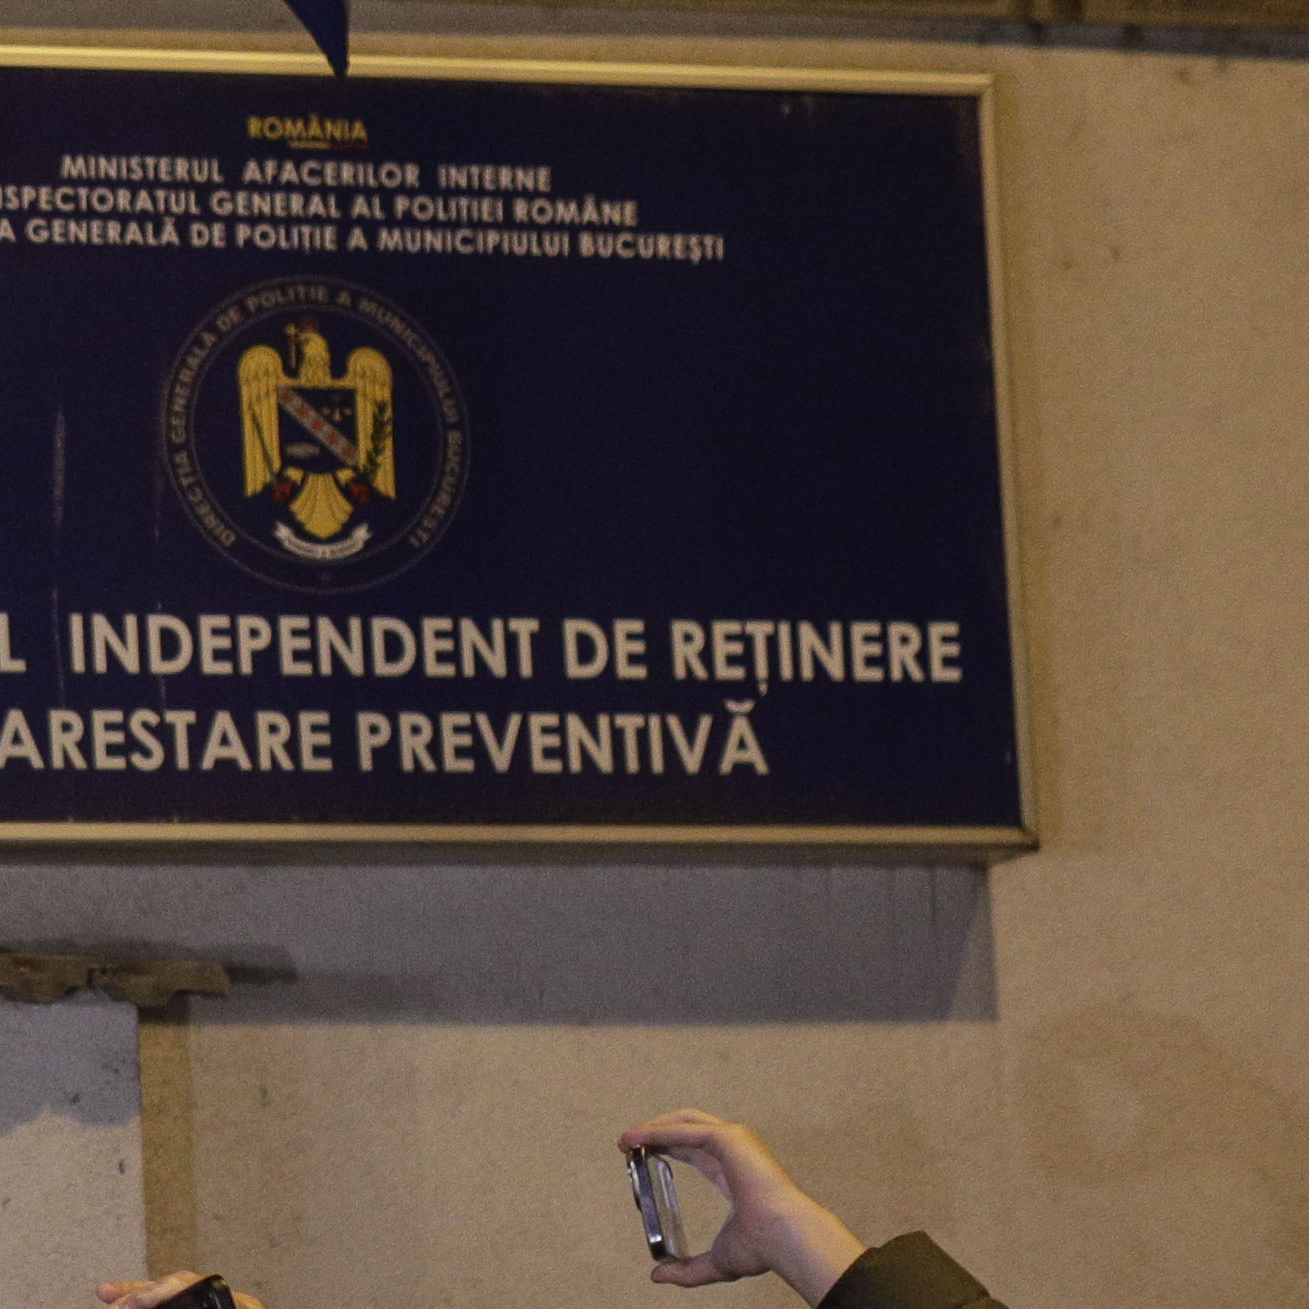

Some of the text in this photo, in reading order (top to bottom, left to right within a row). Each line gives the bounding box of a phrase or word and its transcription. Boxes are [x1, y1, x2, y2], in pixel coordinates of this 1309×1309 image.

[247, 114, 368, 143] ROMÂNIA
[61, 155, 552, 193] MINISTERUL AFACERILOR INTERNE
[209, 190, 341, 219] GENERAL
[350, 195, 385, 219] AL
[513, 194, 638, 227] ROMÂNE
[25, 216, 180, 246] GENERALĂ
[189, 222, 227, 248] DE
[347, 228, 368, 252] A
[377, 228, 570, 257] MUNICIPIULUI
[69, 611, 539, 679] INDEPENDENT
[562, 618, 648, 680] DE
[356, 700, 770, 776] PREVENTIVĂ
